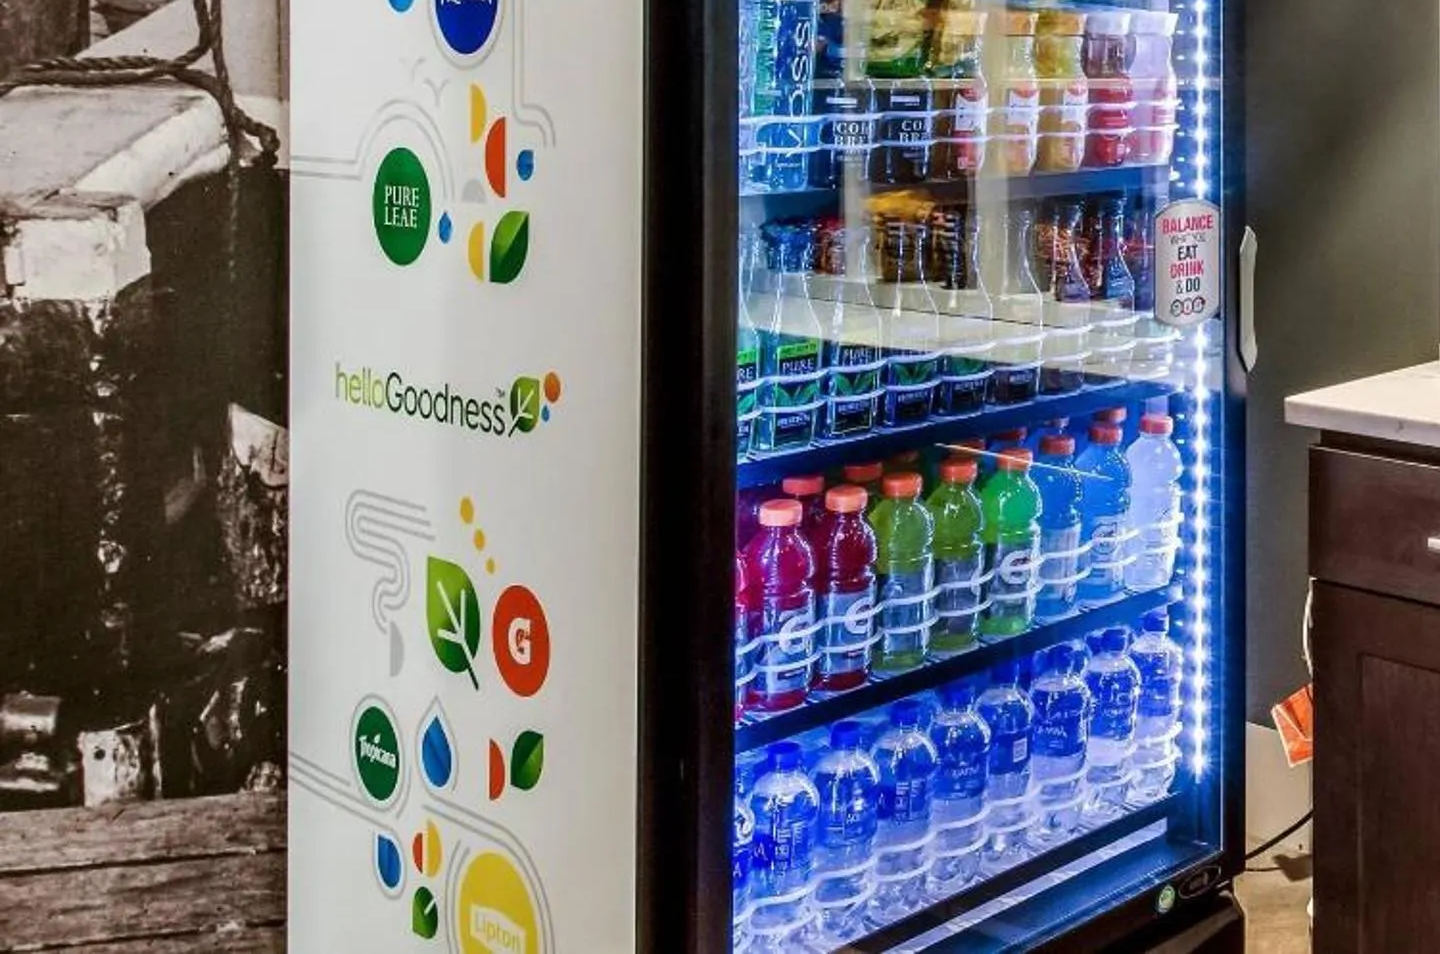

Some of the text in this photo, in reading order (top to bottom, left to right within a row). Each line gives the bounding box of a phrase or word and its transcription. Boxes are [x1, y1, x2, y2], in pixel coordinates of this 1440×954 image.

[383, 183, 420, 209] PURE
[383, 206, 418, 229] LEAF
[1161, 214, 1214, 235] BALANCE
[1177, 245, 1199, 261] EAT
[1170, 260, 1205, 279] DRINK
[1185, 278, 1201, 292] DO
[737, 367, 754, 381] RE
[335, 362, 505, 435] helloGoodness
[507, 617, 533, 666] G
[357, 734, 398, 771] Tropicana
[474, 909, 521, 954] Lipton
